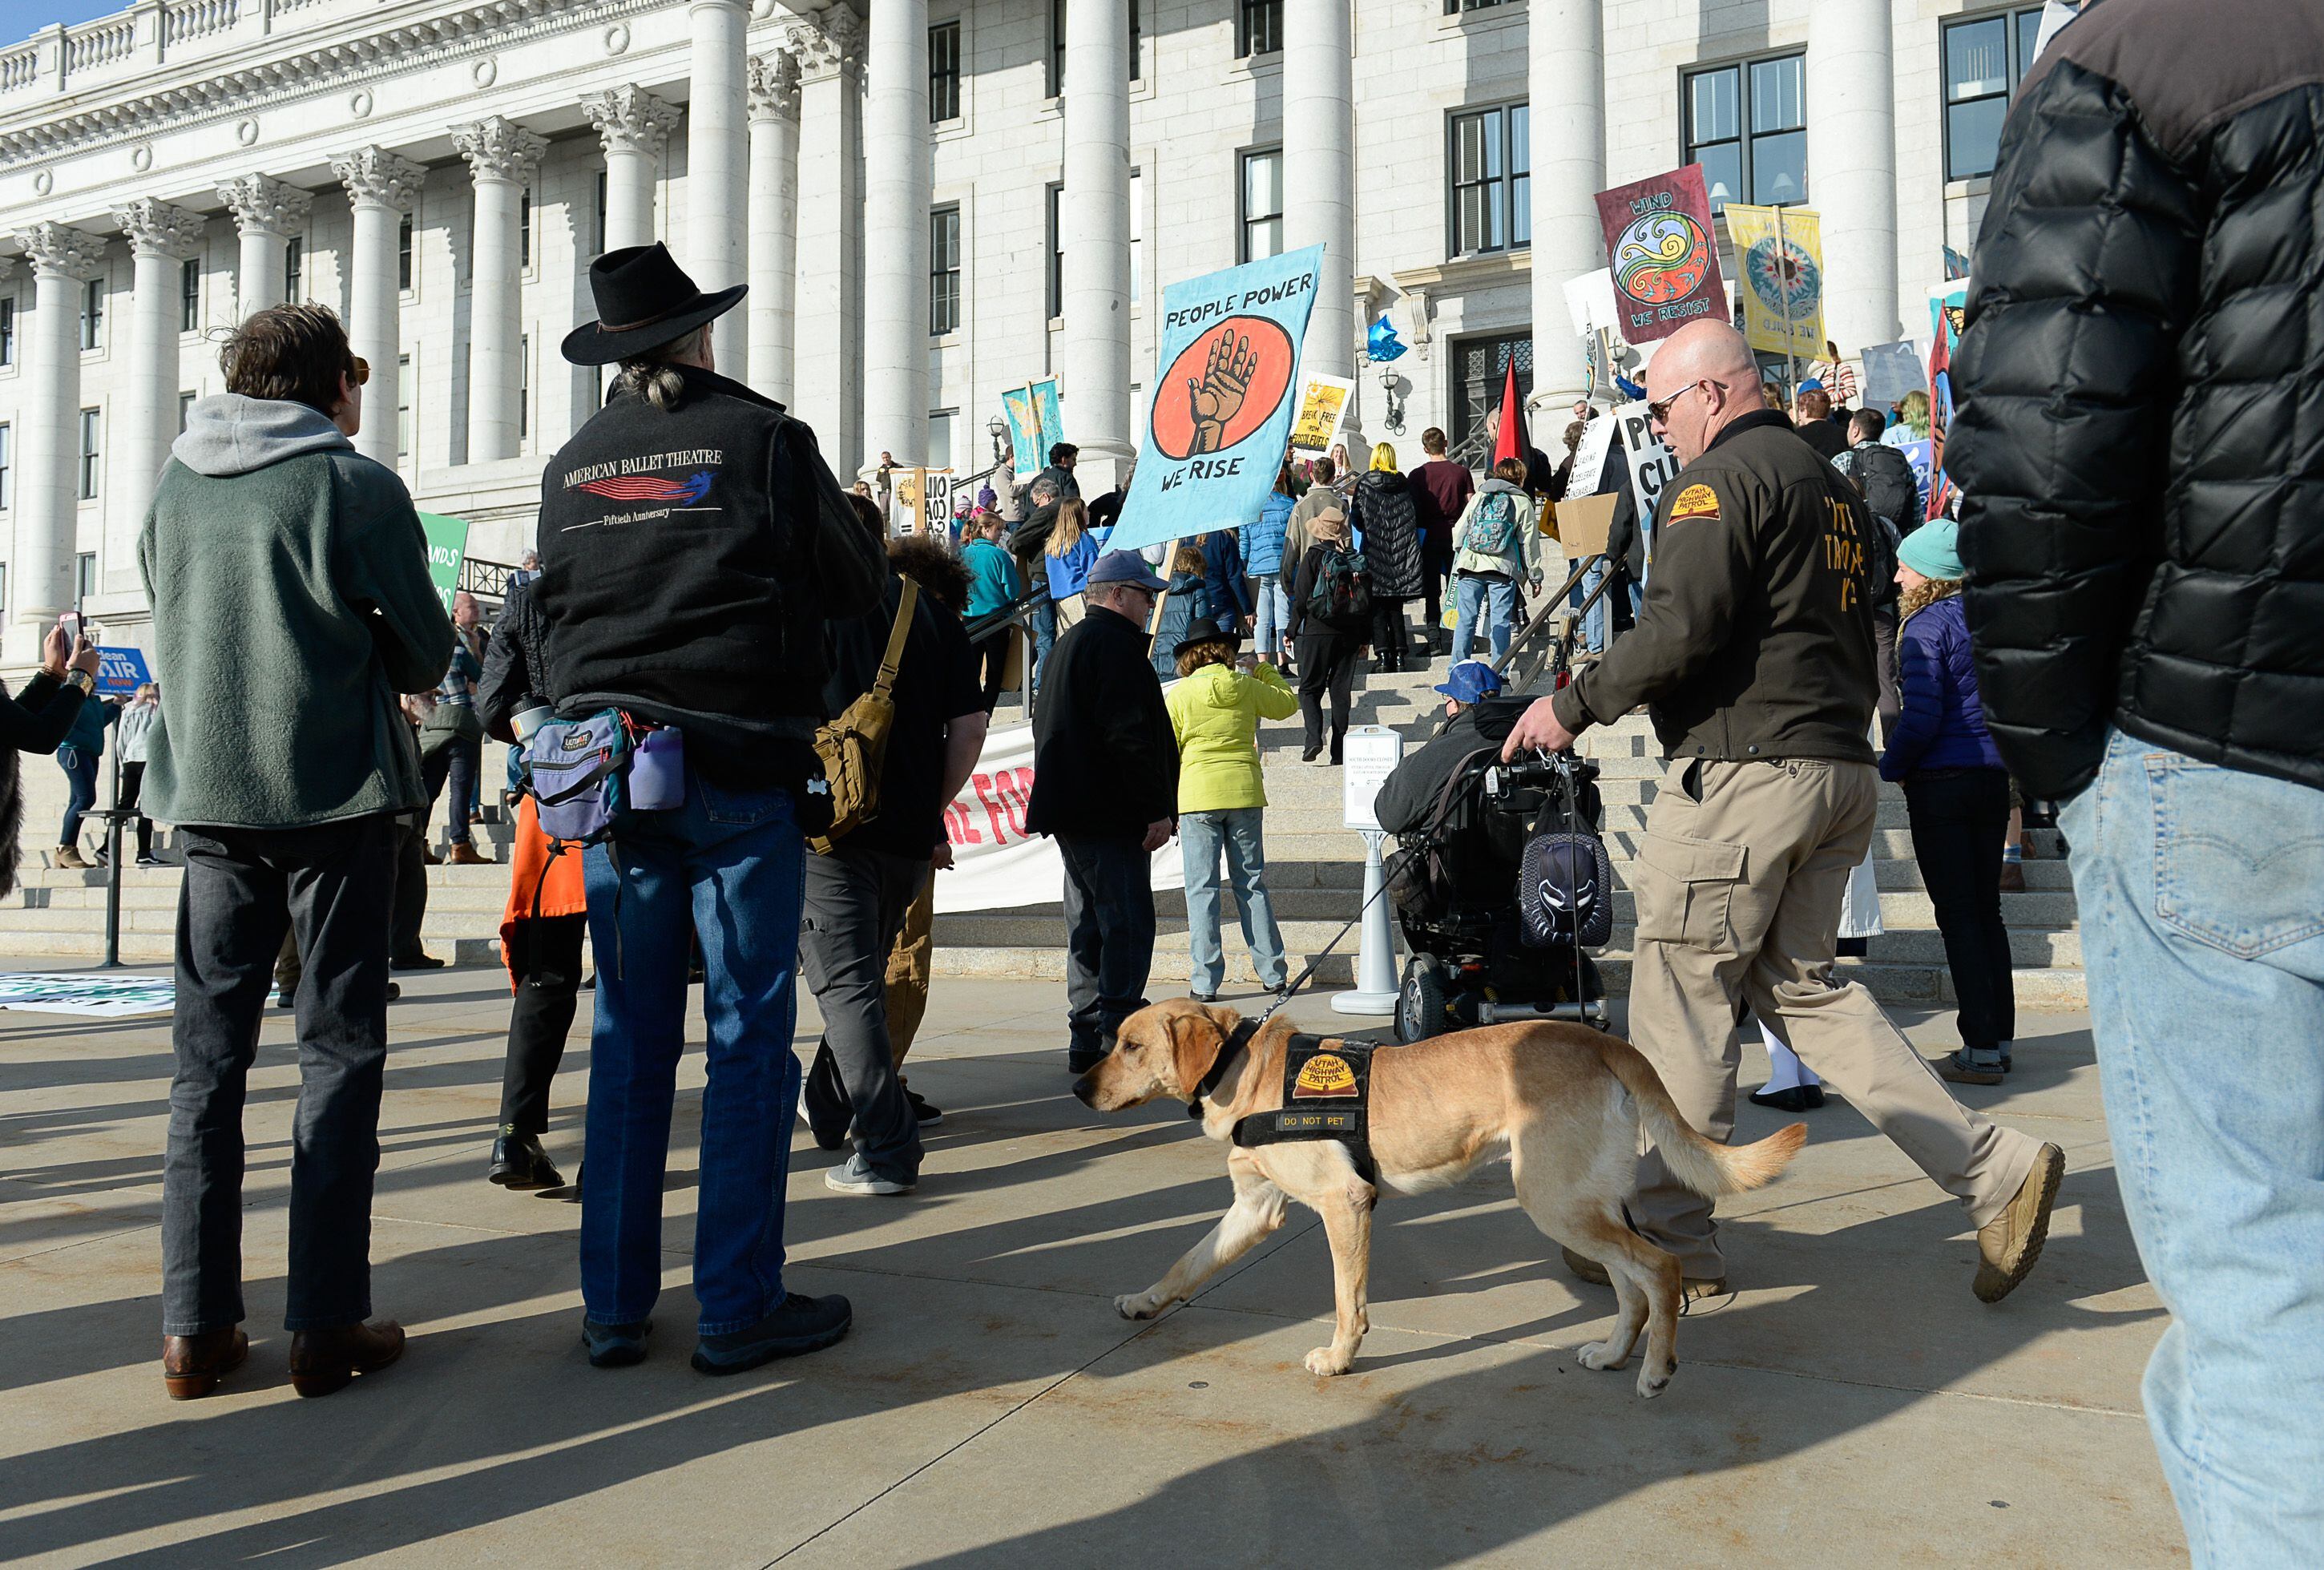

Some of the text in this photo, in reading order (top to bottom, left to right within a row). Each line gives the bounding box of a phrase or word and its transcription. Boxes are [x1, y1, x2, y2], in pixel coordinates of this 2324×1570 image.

[1629, 192, 1672, 216] WIND
[1166, 272, 1313, 330] PEOPLE POWER
[1631, 297, 1710, 328] WE RESIST
[1321, 411, 1337, 423] FREE
[1308, 425, 1320, 433] FROM
[1293, 433, 1329, 448] FOSSIL FUELS
[563, 449, 722, 489] AMERICAN BALLET THEATRE
[1161, 456, 1245, 493] WE RISE
[1677, 491, 1711, 503] HIGHWAY
[1684, 486, 1706, 496] UTAH
[1679, 499, 1709, 510] PATROL
[603, 507, 670, 526] Fiftieth Anniversary
[98, 660, 140, 678] AIR
[1314, 1059, 1338, 1068] UTAH
[1305, 1064, 1346, 1076] HIGHWAY
[1308, 1074, 1344, 1084] PATROL
[1284, 1116, 1345, 1126] DO NOT PET
